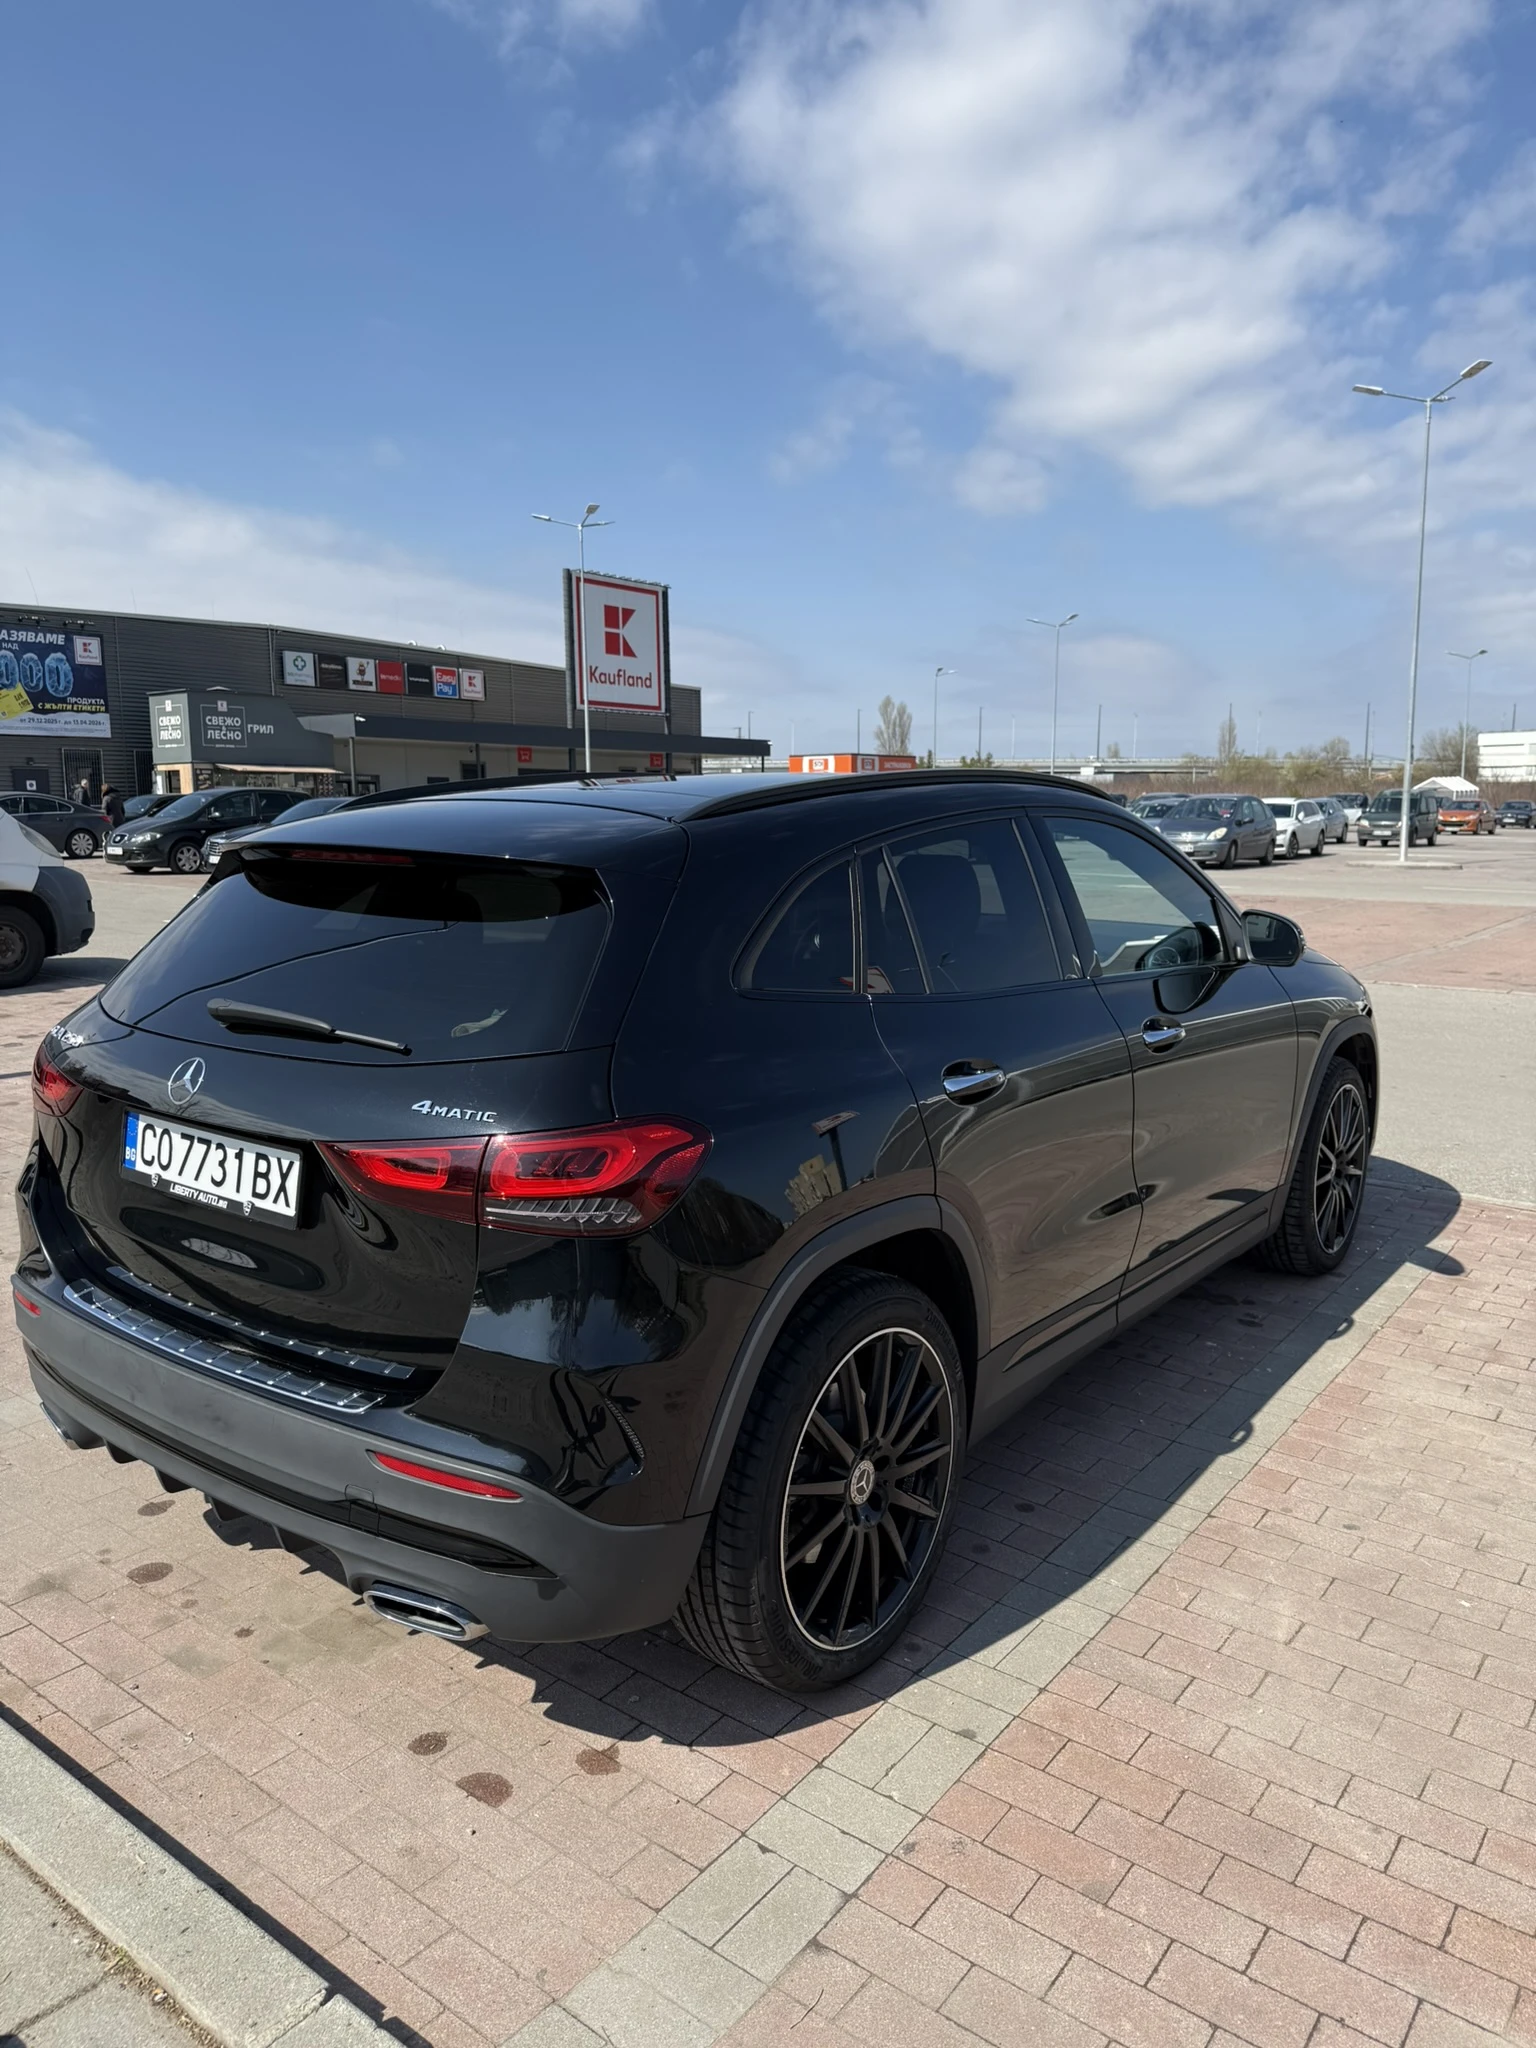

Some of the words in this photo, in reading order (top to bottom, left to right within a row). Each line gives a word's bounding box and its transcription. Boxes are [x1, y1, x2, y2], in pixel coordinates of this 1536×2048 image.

[2, 642, 20, 650] НАД
[436, 672, 456, 685] Easy
[589, 665, 652, 689] Kaufland
[437, 683, 453, 695] Pay
[67, 697, 105, 705] ПРОДУКТА
[73, 704, 105, 712] ЕТИКЕТИ
[159, 715, 181, 726] СВЕЖО
[205, 715, 241, 726] СВЕЖО
[247, 724, 274, 734] ГРИЛ
[160, 730, 182, 740] ЛЕСНО
[207, 730, 242, 740] ЛЕСНО
[411, 1099, 497, 1122] 4MATIC
[125, 1147, 136, 1161] BG
[170, 1182, 200, 1200] LIBERTY
